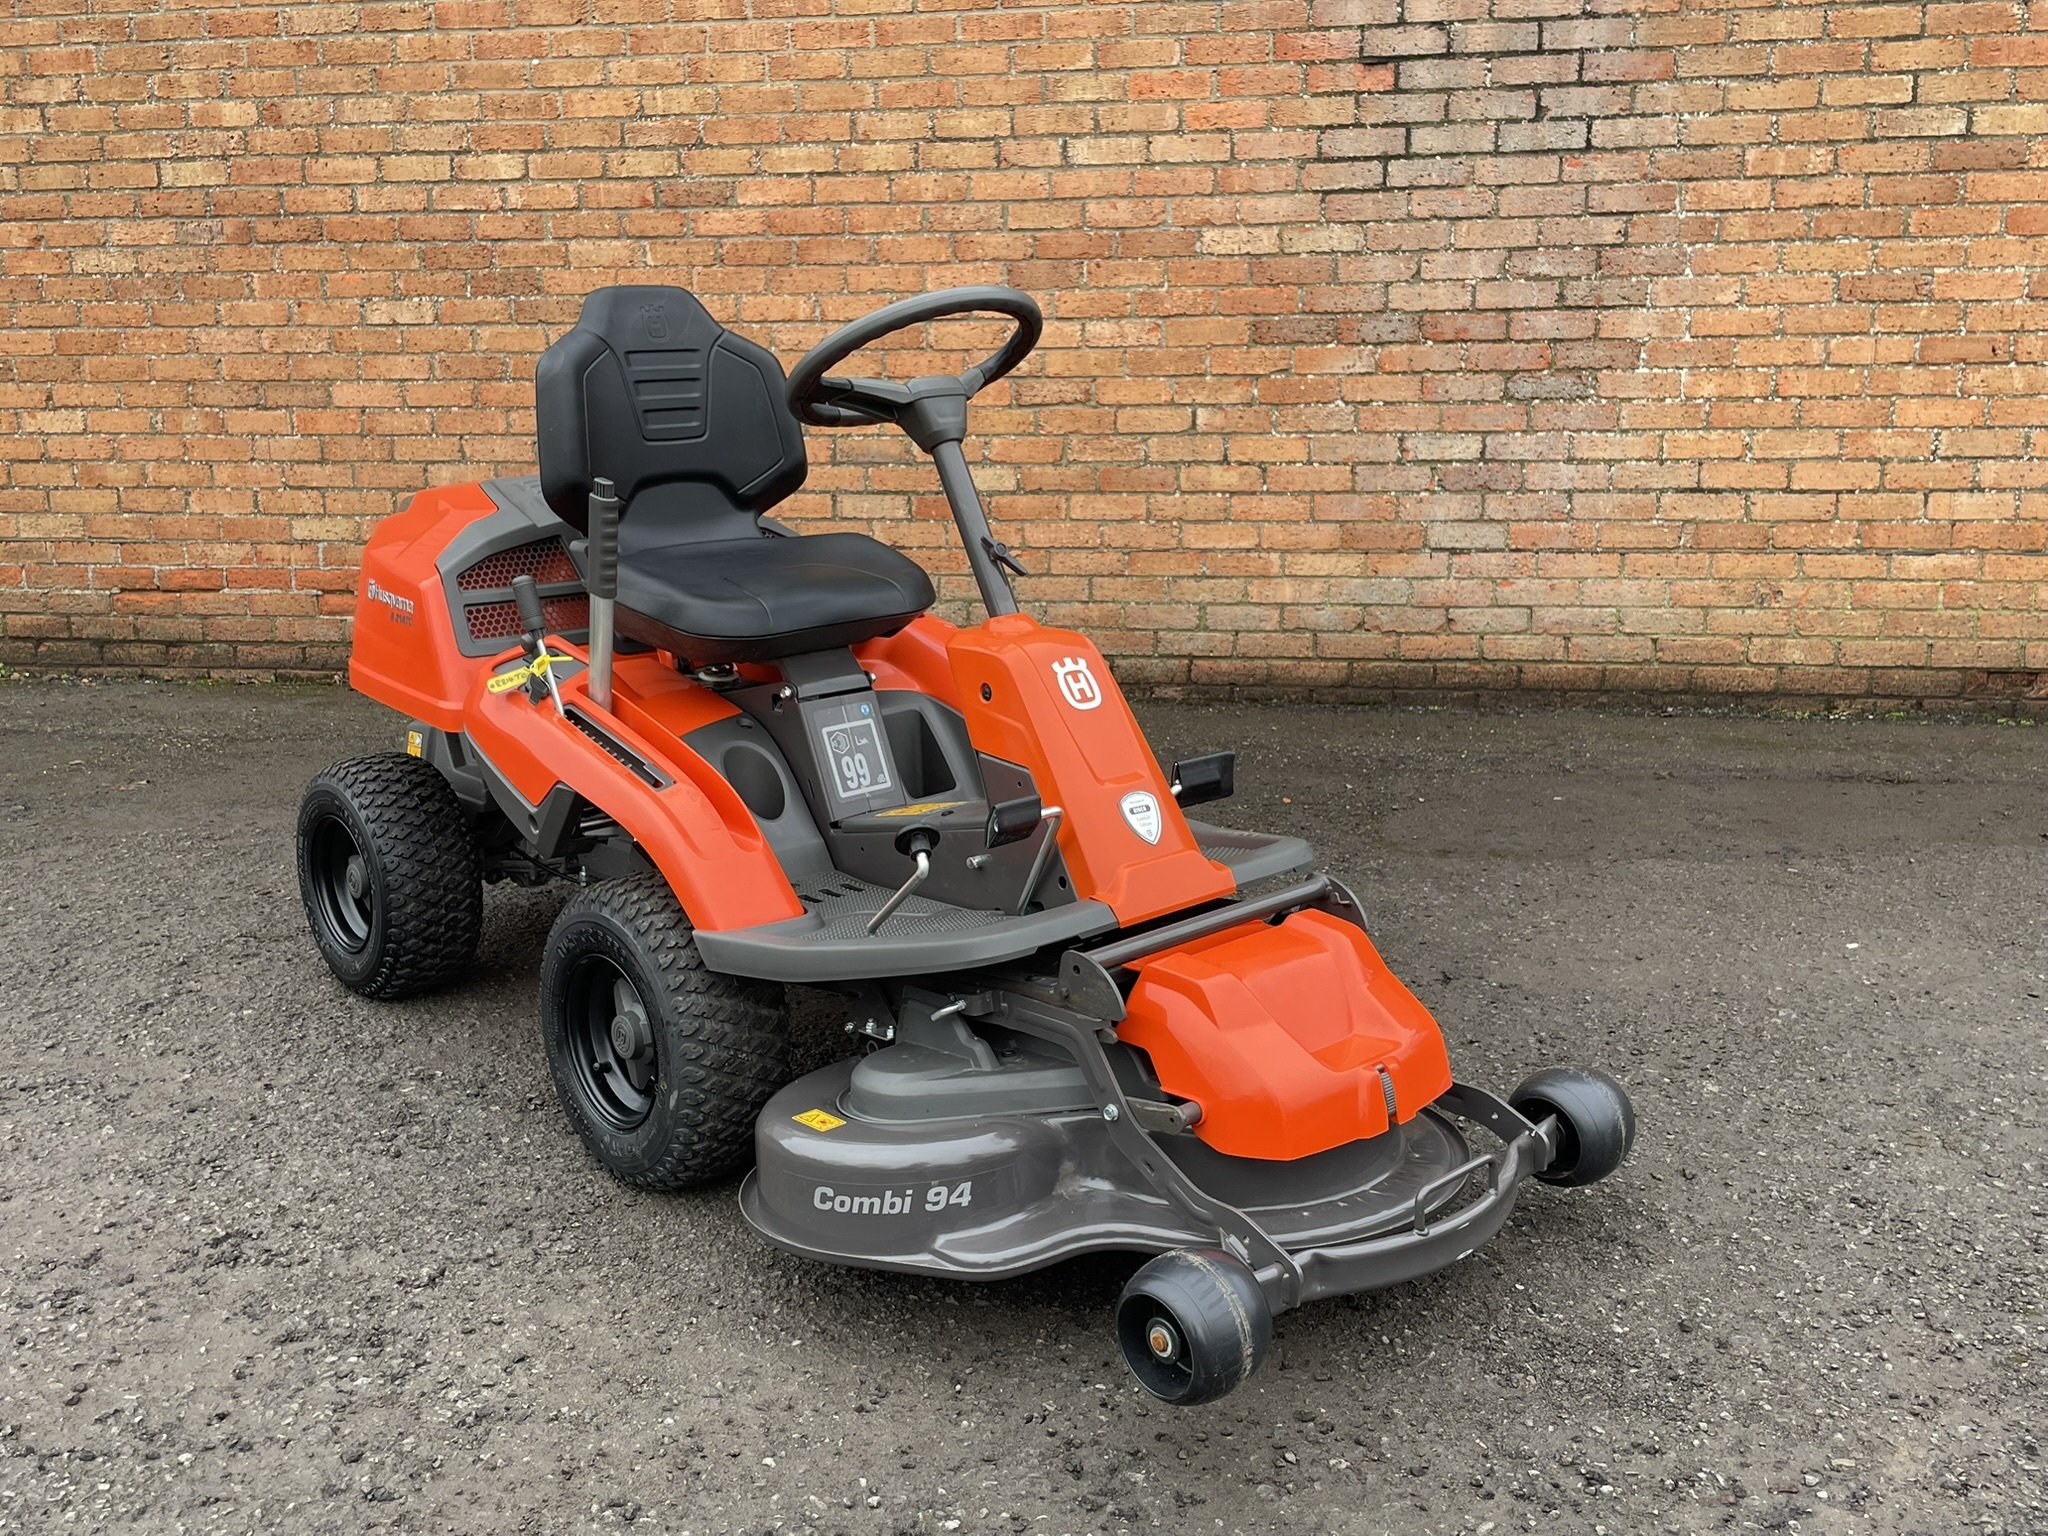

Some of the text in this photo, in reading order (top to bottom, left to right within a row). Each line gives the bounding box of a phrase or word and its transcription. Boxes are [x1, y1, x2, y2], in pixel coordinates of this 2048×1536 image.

[374, 583, 414, 614] Husqvarna
[841, 752, 871, 789] 99
[813, 1181, 973, 1215] Combi 94
